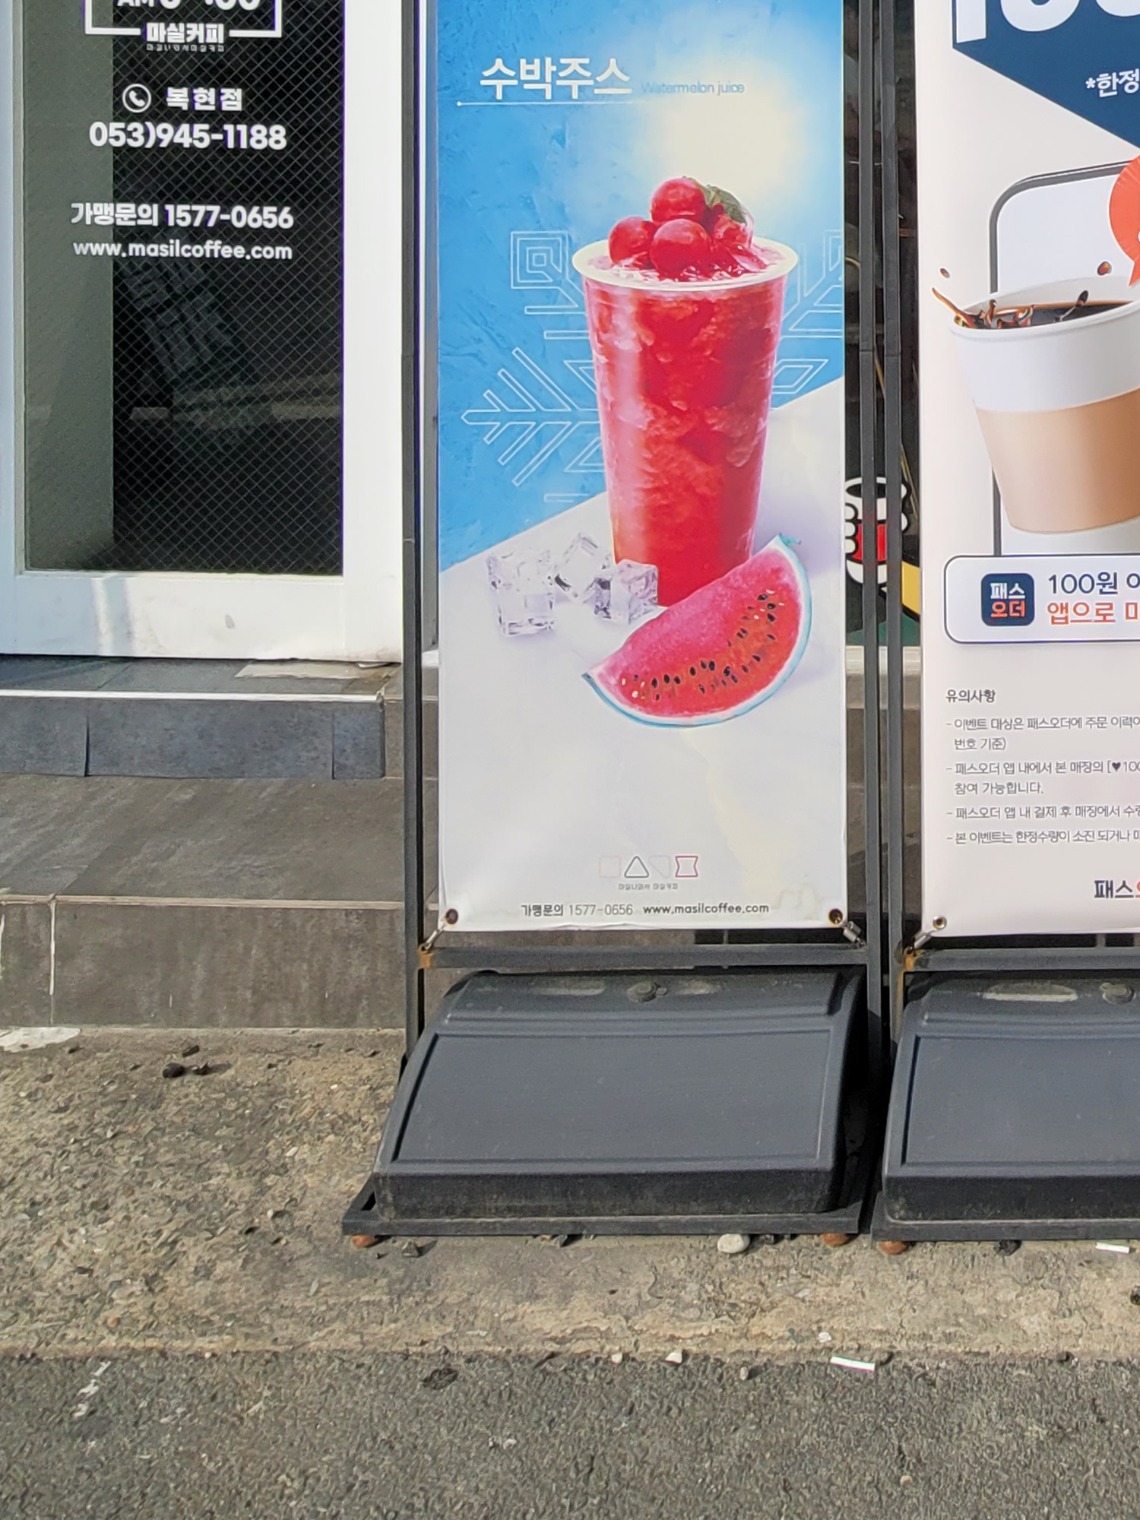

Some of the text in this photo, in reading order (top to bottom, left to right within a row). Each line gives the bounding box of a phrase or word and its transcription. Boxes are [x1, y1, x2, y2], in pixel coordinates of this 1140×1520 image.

[146, 22, 224, 44] 마실커피
[479, 56, 632, 100] 수박주스
[716, 80, 745, 97] juice
[166, 87, 242, 111] 복현점
[88, 123, 287, 150] 053)945-1188
[71, 203, 294, 229] 가맹문의 1577-0656
[73, 240, 293, 260] www.masilcoffee.com
[990, 582, 1026, 600] 패스
[1047, 572, 1118, 596] 100원
[990, 601, 1026, 619] 오더
[1047, 601, 1116, 626] 앱으로
[945, 689, 996, 703] 유의사항
[954, 717, 988, 731] 이벤트
[990, 717, 1024, 731] 대상은
[1027, 716, 1083, 730] 패스오더에
[1085, 716, 1108, 730] 주문
[954, 736, 1007, 751] 번호 기준)
[955, 762, 1000, 775] 패스오더
[1003, 762, 1015, 775] 앱
[1018, 761, 1052, 774] 내에서
[1055, 761, 1067, 773] 본
[1069, 761, 1104, 774] 매장의
[955, 782, 1044, 795] 참여 가능합니다.
[956, 806, 1000, 819] 패스오더
[1004, 806, 1016, 819] 앱
[1019, 806, 1031, 819] 내
[1034, 806, 1057, 818] 결제
[1060, 805, 1071, 818] 후
[1075, 805, 1120, 818] 매장에서
[955, 831, 966, 844] 본
[969, 831, 1013, 844] 이벤트는
[1016, 830, 1070, 843] 한정수량이
[1072, 830, 1095, 843] 소진
[1097, 829, 1130, 842] 되거나
[521, 902, 770, 917] 가맹문의 1577-0656 www.masilcoffee.com
